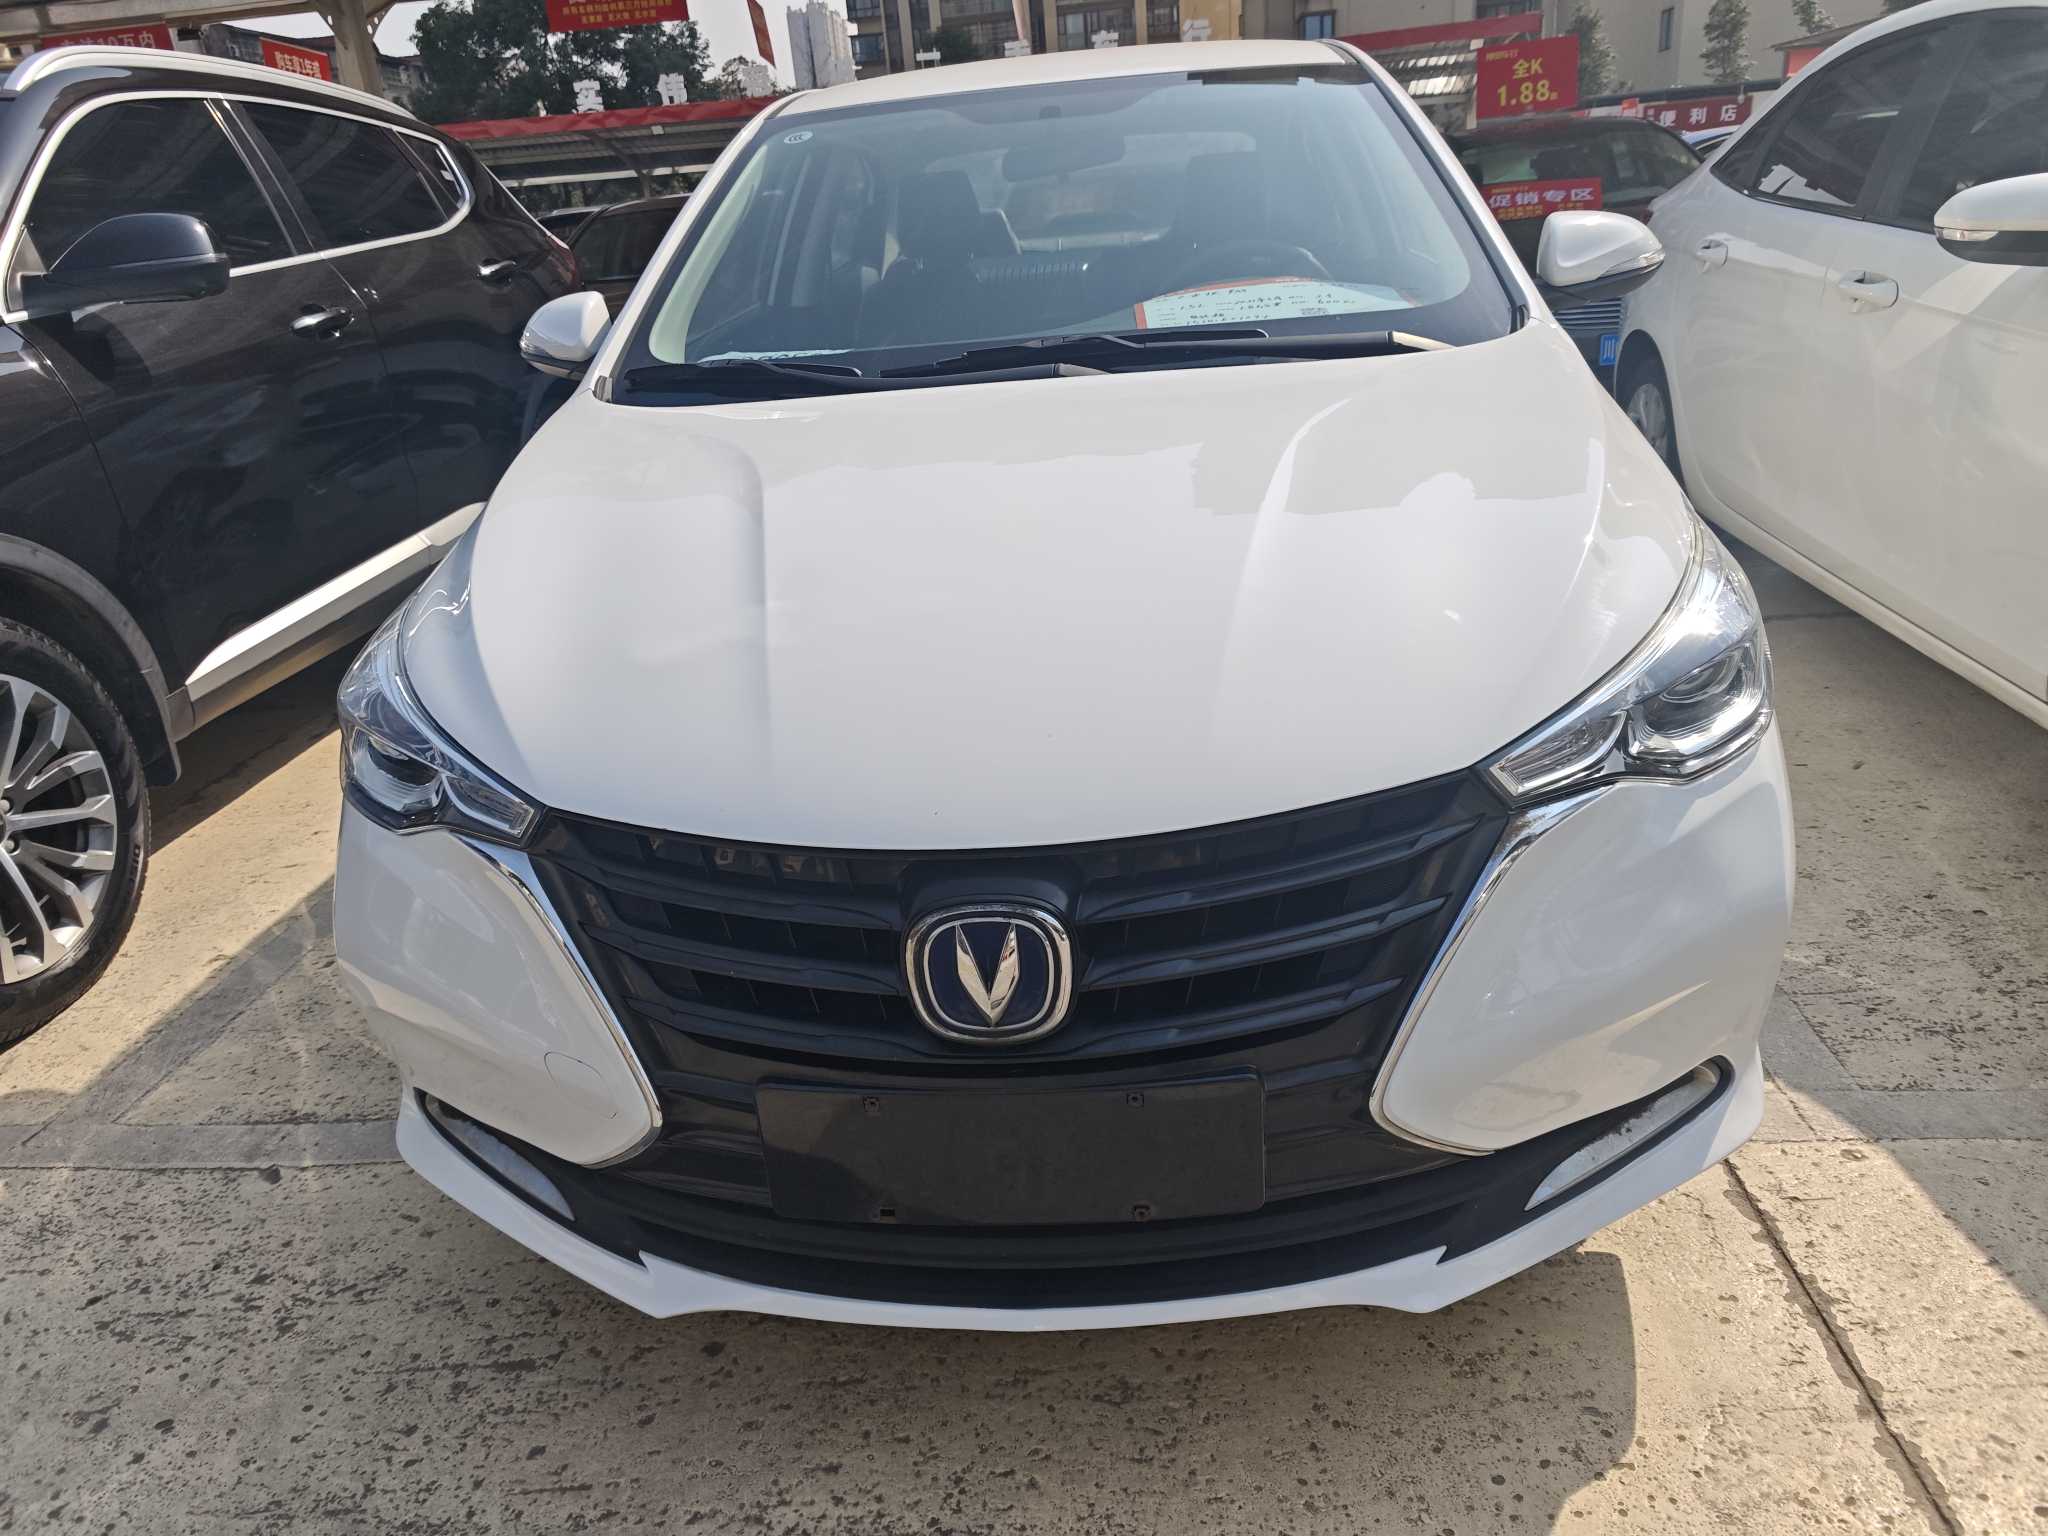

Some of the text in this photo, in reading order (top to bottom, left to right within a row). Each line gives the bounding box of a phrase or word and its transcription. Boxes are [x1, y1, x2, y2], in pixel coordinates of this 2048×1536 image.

[1512, 57, 1543, 80] 全K
[1659, 104, 1738, 127] 便利店
[1488, 187, 1596, 208] 促销专区
